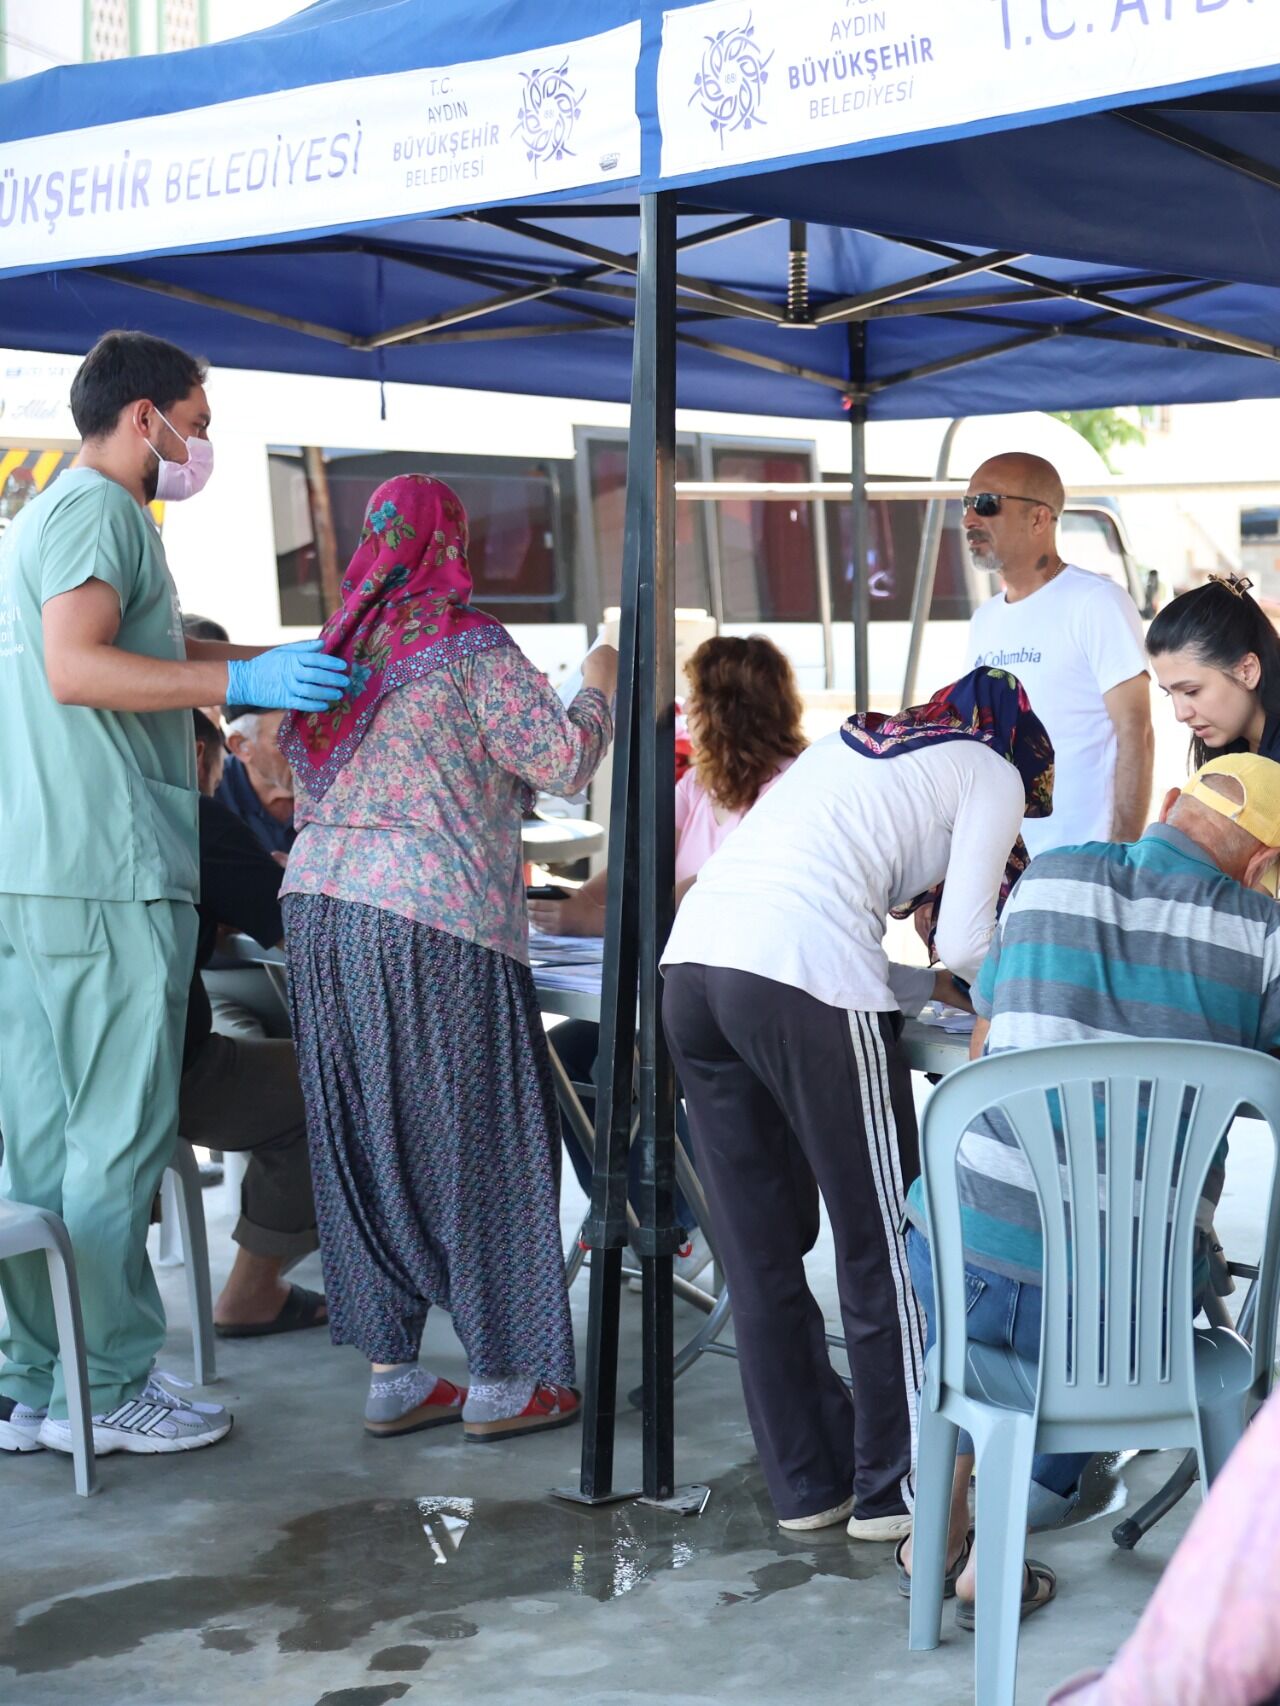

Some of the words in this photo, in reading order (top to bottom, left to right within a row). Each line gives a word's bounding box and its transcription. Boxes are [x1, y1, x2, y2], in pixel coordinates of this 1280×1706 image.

[830, 11, 886, 42] AYDIN
[788, 34, 934, 90] BÜYÜKŞEHİR
[430, 77, 454, 96] T.C.
[809, 75, 914, 120] BELEDİYESİ
[428, 101, 468, 123] AYDIN
[393, 121, 500, 162] BÜYÜKŞEHİR
[165, 119, 363, 204] BELEDİYESİ
[406, 155, 485, 188] BELEDİYESİ
[983, 647, 1041, 667] Columbia
